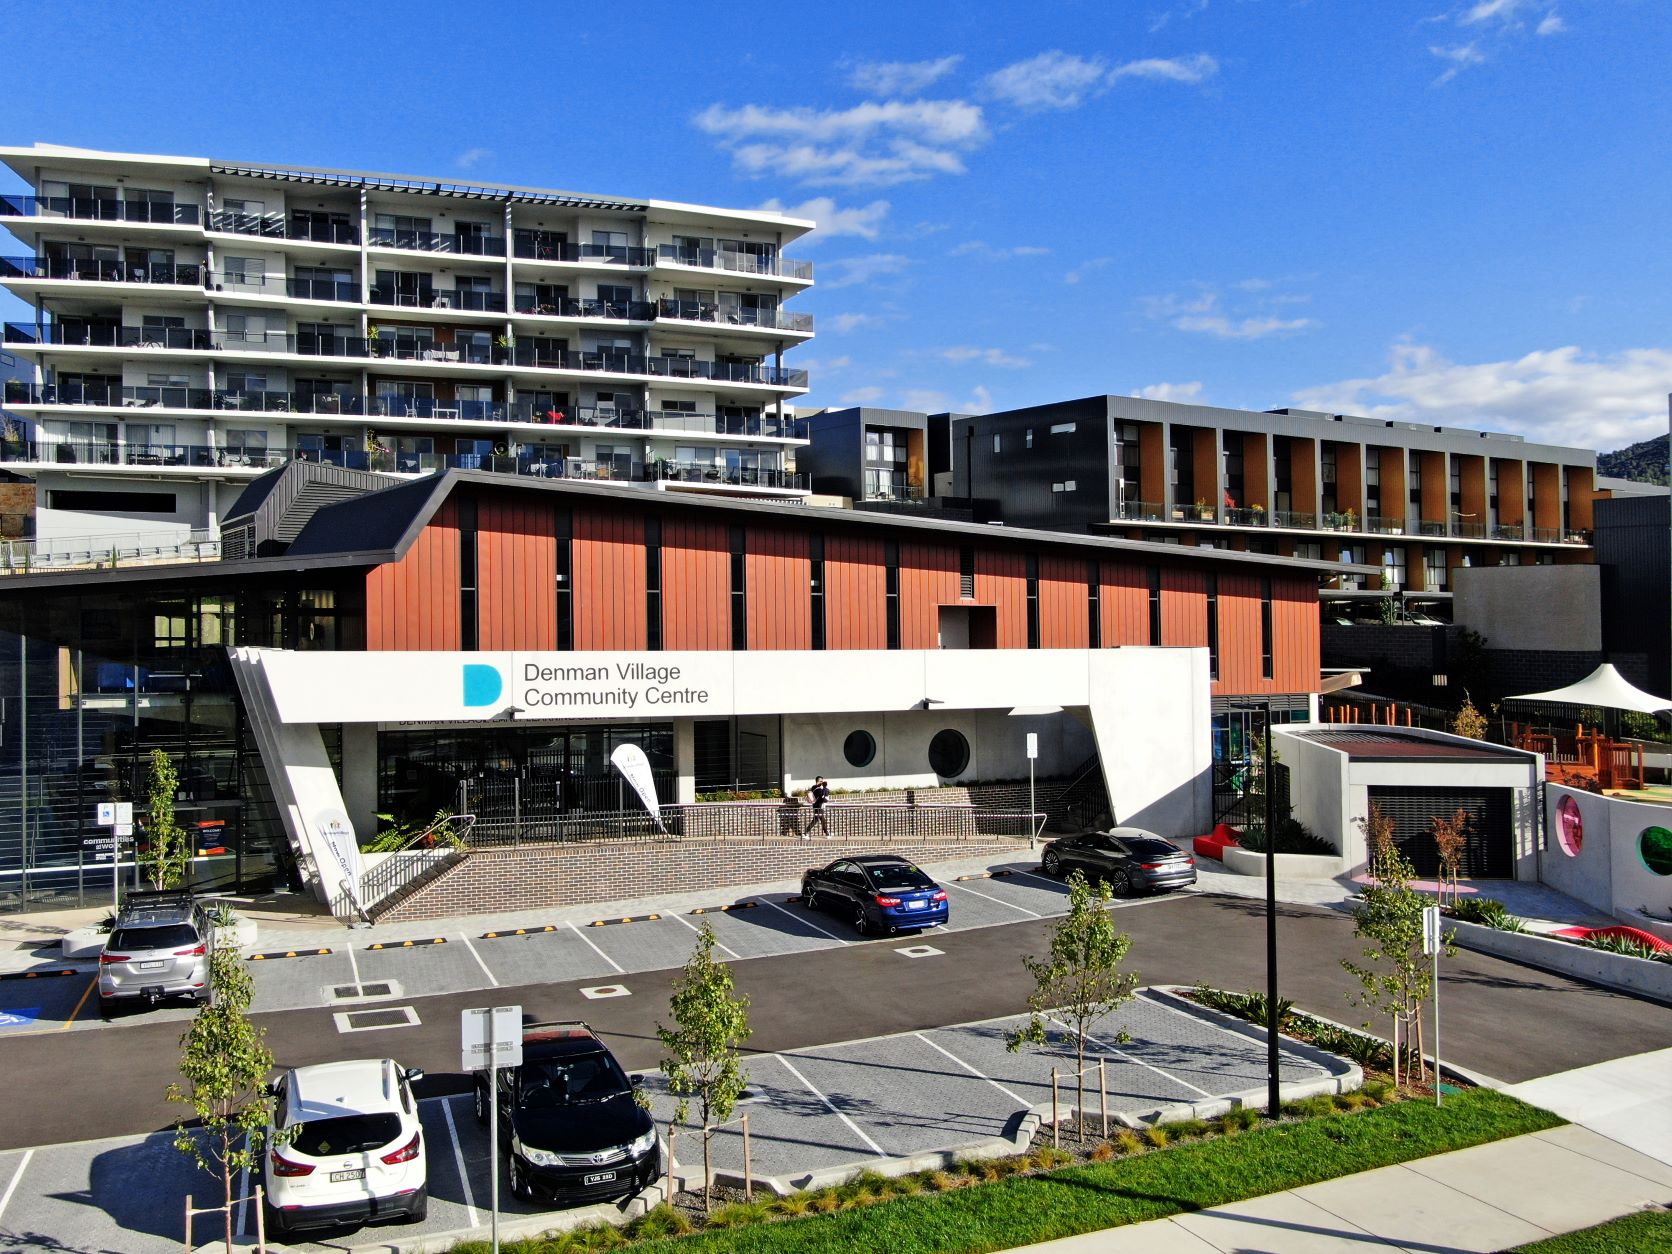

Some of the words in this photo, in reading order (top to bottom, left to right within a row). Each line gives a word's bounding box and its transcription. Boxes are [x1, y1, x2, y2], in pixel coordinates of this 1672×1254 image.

[524, 663, 609, 681] Denman
[616, 663, 681, 684] Village
[524, 688, 639, 708] Community
[645, 687, 709, 704] Centre
